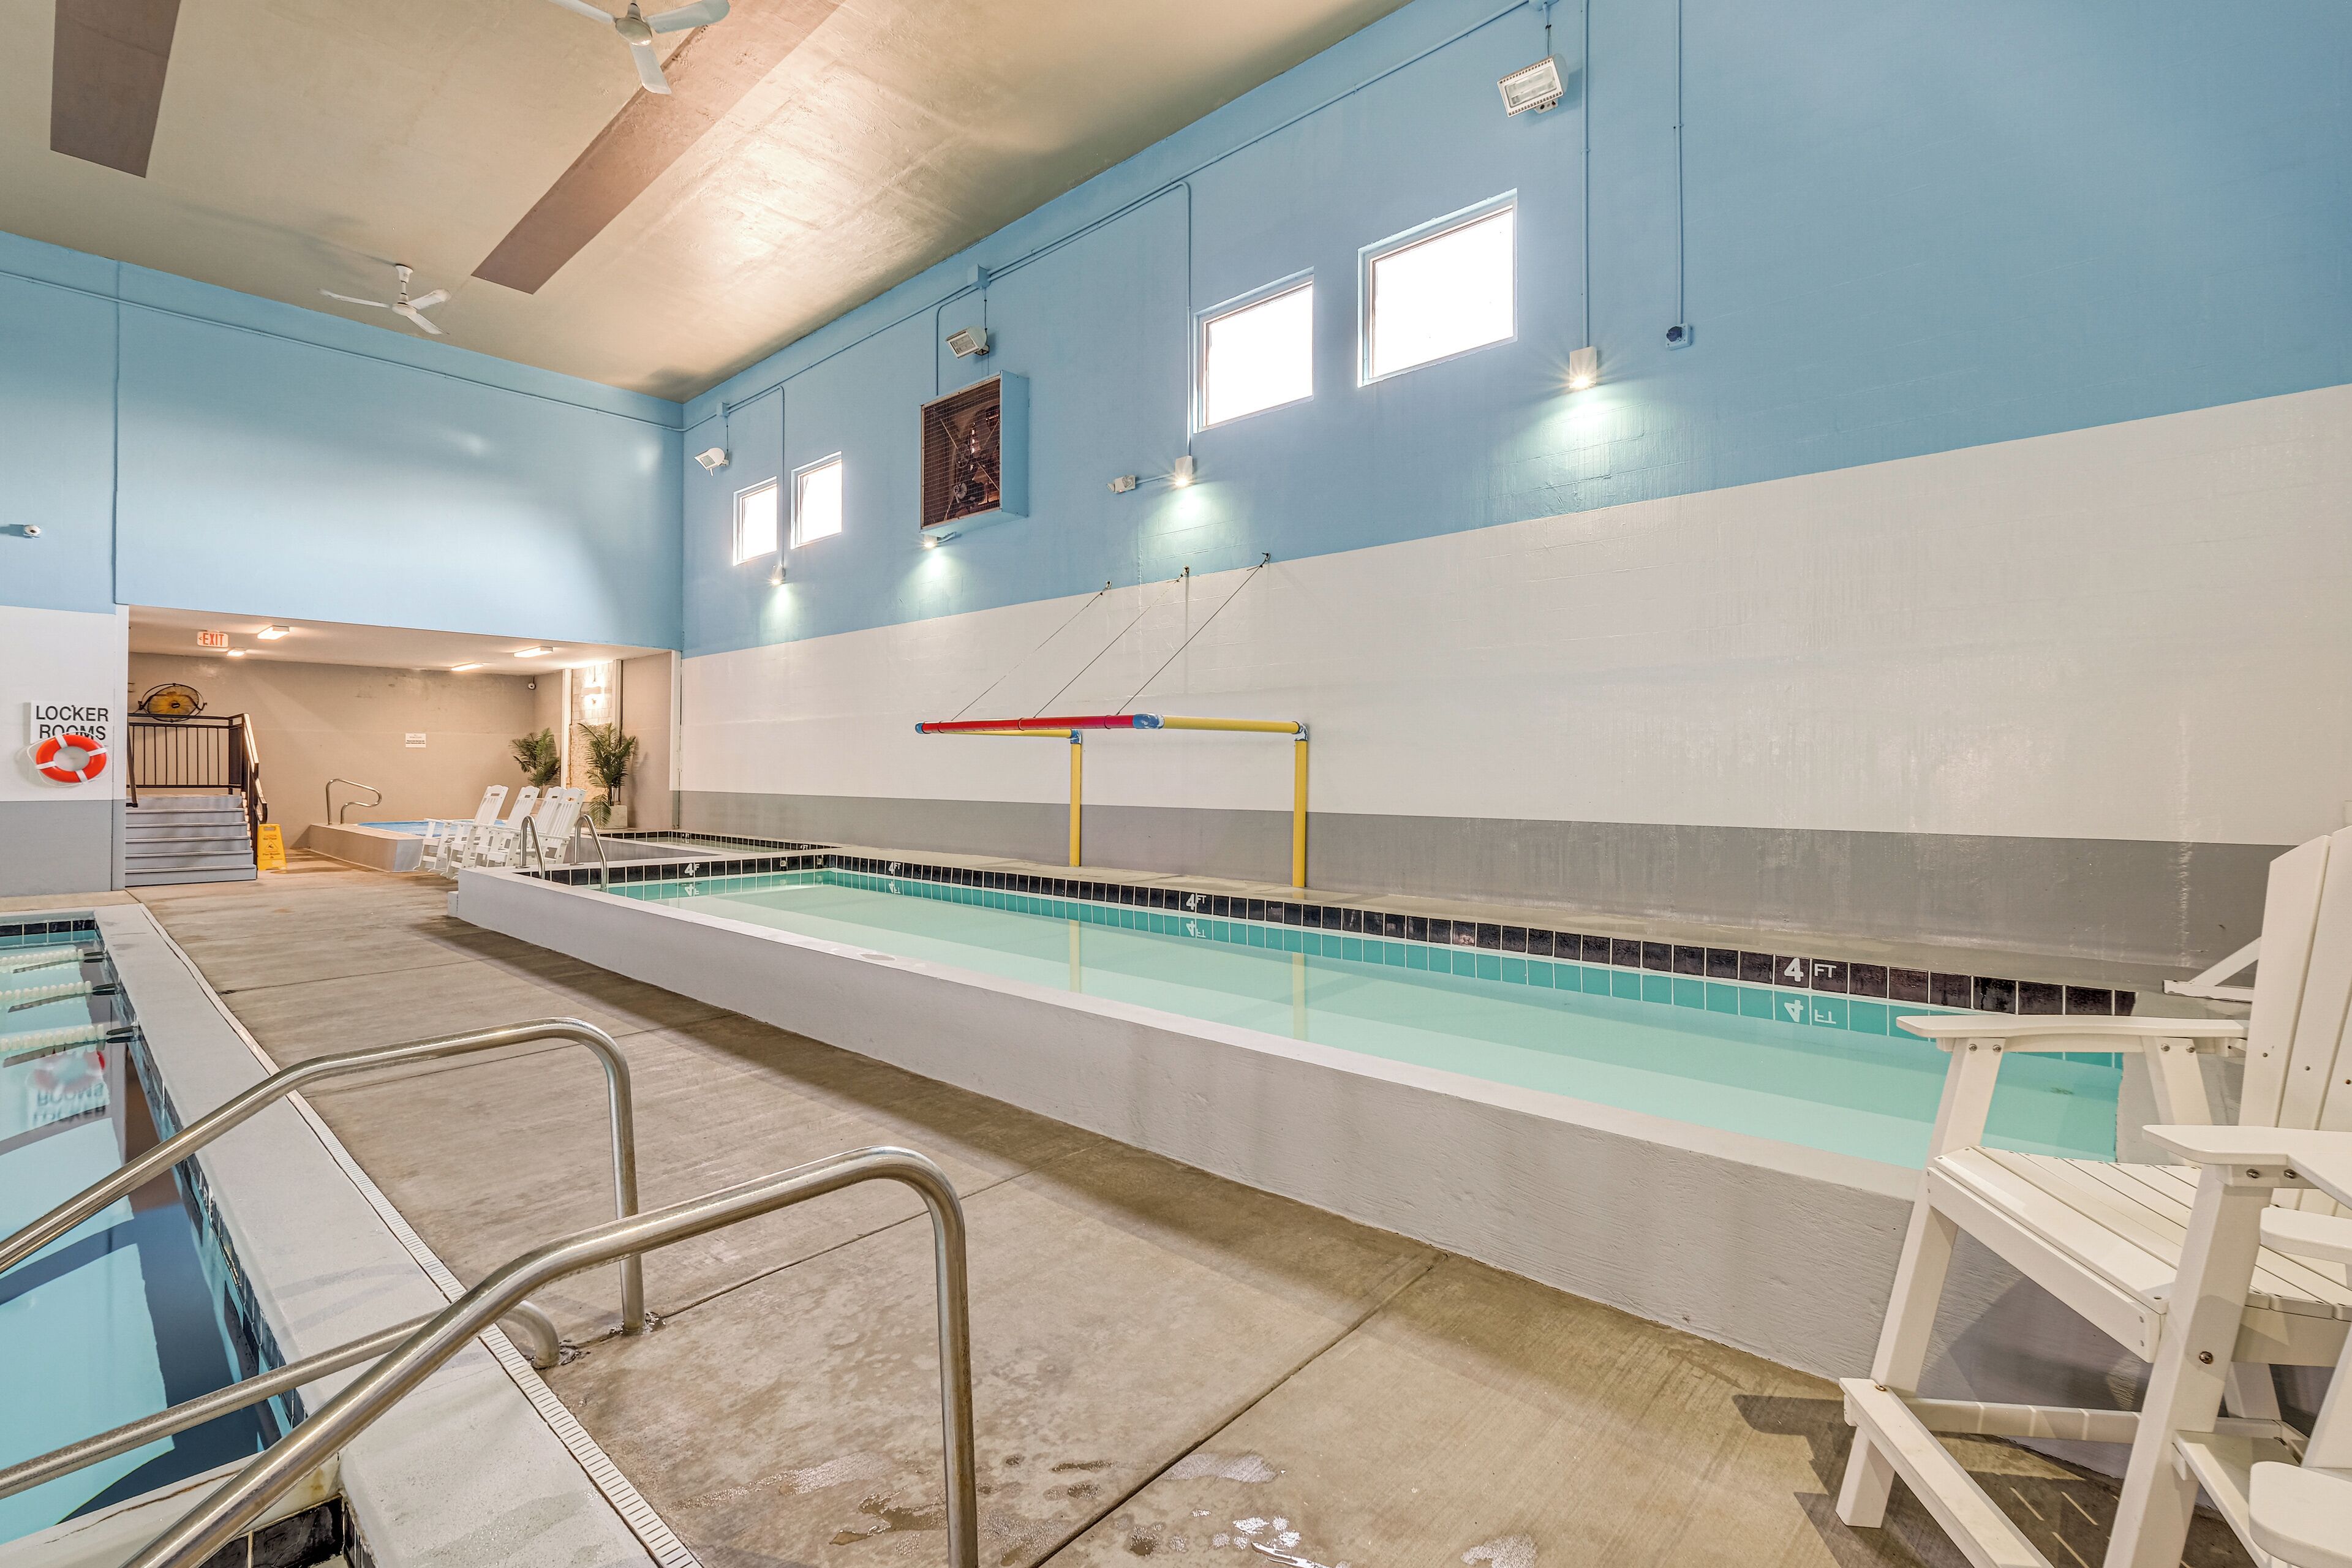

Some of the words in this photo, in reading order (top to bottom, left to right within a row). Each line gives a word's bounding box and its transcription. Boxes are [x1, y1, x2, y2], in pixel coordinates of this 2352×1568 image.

[203, 633, 224, 646] EXIT
[36, 705, 108, 722] LOCKER
[40, 724, 106, 741] ROOMS
[684, 863, 694, 876] 4
[888, 862, 894, 875] 4
[1186, 894, 1196, 910] 4
[1197, 895, 1207, 904] FT
[1784, 957, 1804, 982] 4
[1814, 963, 1837, 978] FT
